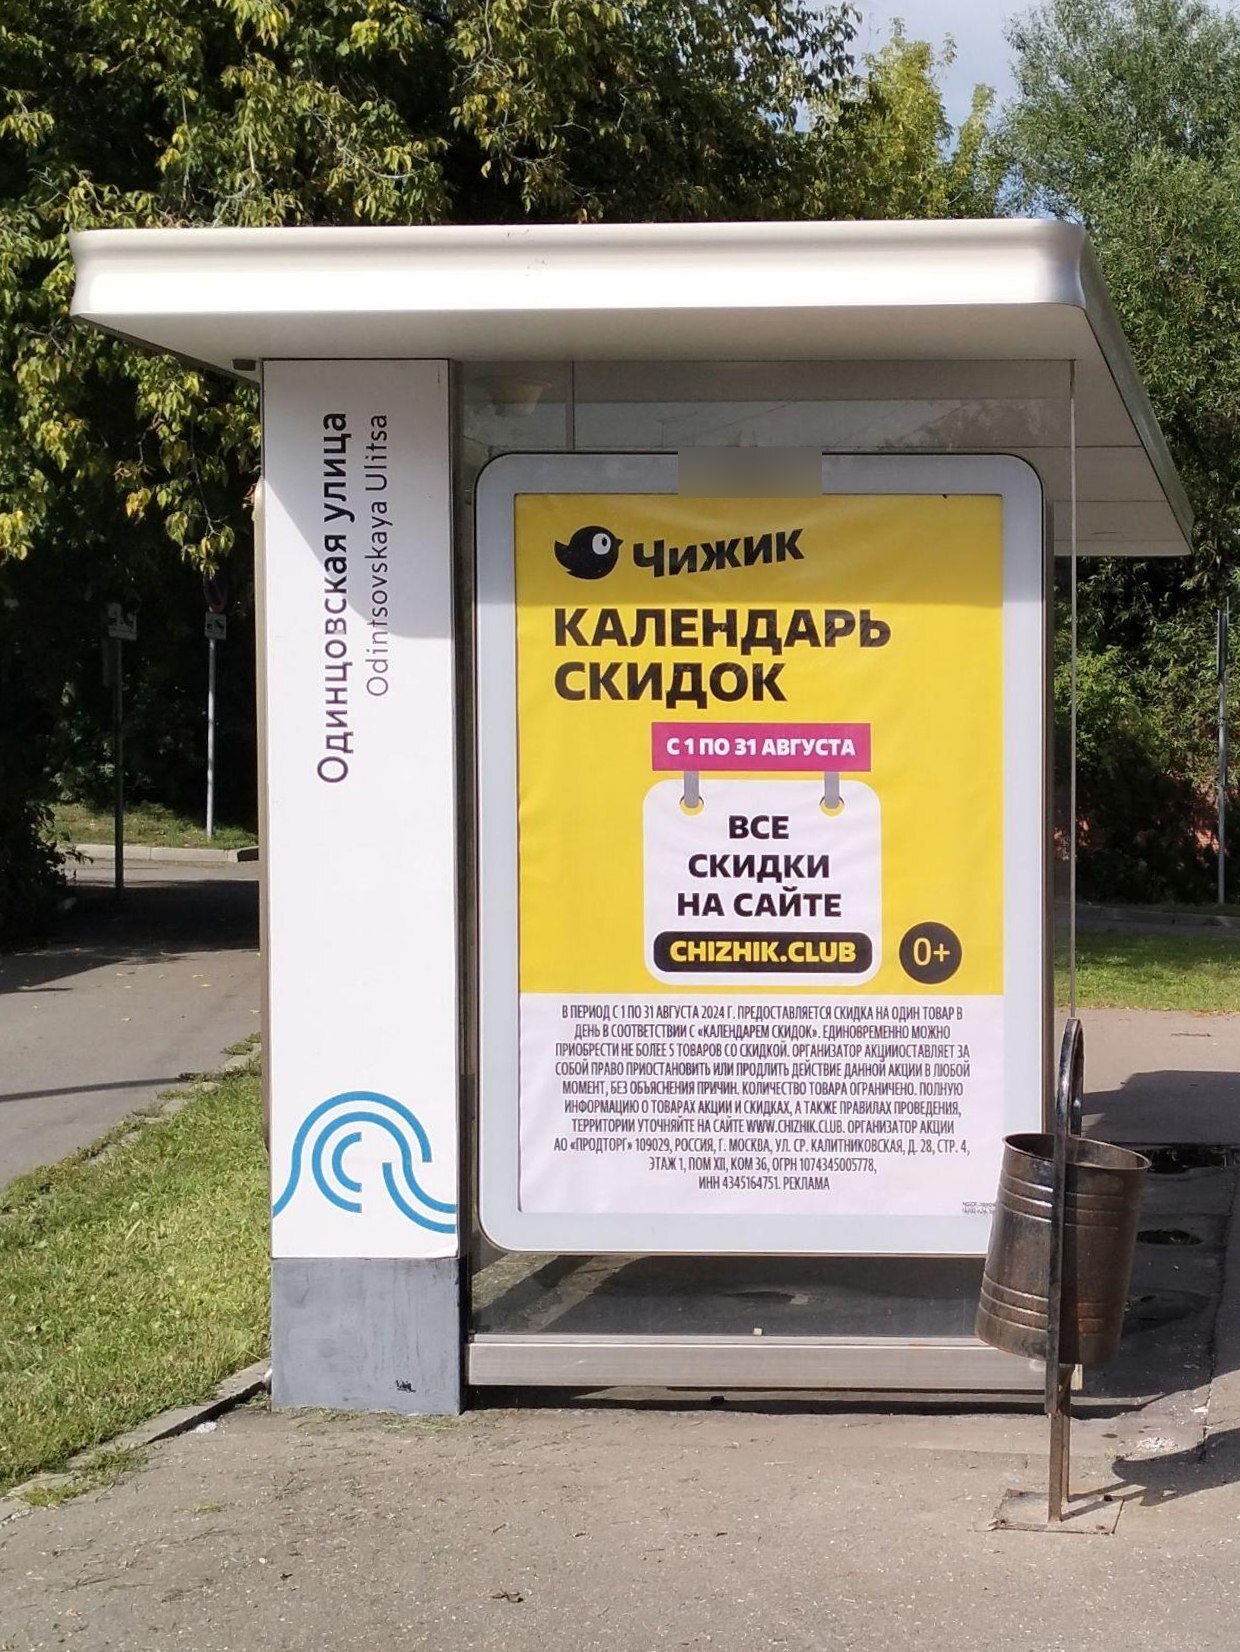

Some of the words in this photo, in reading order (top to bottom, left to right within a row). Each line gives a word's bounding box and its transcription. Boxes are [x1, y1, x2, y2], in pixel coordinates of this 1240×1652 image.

[363, 414, 388, 491] Ulitsa
[322, 412, 356, 524] улица
[363, 501, 394, 696] Odintsovskaya
[554, 608, 891, 656] КАЛЕНДАРЬ
[316, 533, 354, 784] Одинцовская
[554, 661, 787, 710] СКИДОК
[666, 737, 680, 756] С
[683, 737, 694, 755] 1
[699, 737, 730, 756] ПО
[734, 738, 757, 756] 31
[761, 738, 856, 756] АВГУСТА
[728, 815, 790, 840] ВСЕ
[688, 853, 830, 884] СКИДКИ
[677, 892, 725, 917] НА
[733, 885, 842, 918] САЙТЕ
[669, 940, 857, 963] CHIZHIK.CLUB
[913, 937, 951, 966] 0+
[562, 1005, 568, 1018] В
[571, 1005, 610, 1021] ПЕРИОД
[613, 1005, 618, 1018] С
[621, 1005, 625, 1018] 1
[628, 1005, 641, 1018] ПО
[644, 1005, 653, 1018] 31
[656, 1005, 699, 1019] АВГУСТА
[702, 1005, 724, 1019] 2024
[728, 1006, 735, 1019] Г.
[738, 1006, 831, 1022] ПРЕДОСТАВЛЯЕТСЯ
[834, 1006, 873, 1022] СКИДКА
[876, 1006, 889, 1019] НА
[892, 1007, 919, 1022] ОДИН
[923, 1007, 954, 1020] ТОВАР
[957, 1007, 962, 1020] В
[574, 1024, 600, 1040] ДЕНЬ
[603, 1024, 609, 1037] В
[611, 1024, 686, 1038] СООТВЕТСТВИИ
[689, 1025, 695, 1037] С
[698, 1024, 769, 1041] «КАЛЕНДАРЕМ
[772, 1025, 820, 1042] СКИДОК».
[823, 1025, 909, 1041] ЕДИНОВРЕМЕННО
[912, 1025, 950, 1039] МОЖНО
[556, 1043, 619, 1057] ПРИОБРЕСТИ
[621, 1043, 633, 1056] НЕ
[636, 1043, 666, 1057] БОЛЕЕ
[669, 1043, 674, 1057] 5
[676, 1043, 722, 1057] ТОВАРОВ
[725, 1044, 737, 1058] СО
[740, 1041, 789, 1061] СКИДКОЙ.
[792, 1044, 862, 1058] ОРГАНИЗАТОР
[958, 1045, 970, 1058] ЗА
[556, 1059, 588, 1075] СОБОЙ
[591, 1062, 624, 1075] ПРАВО
[626, 1062, 710, 1076] ПРИОСТАНОВИТЬ
[713, 1062, 733, 1076] ИЛИ
[737, 1063, 789, 1079] ПРОДЛИТЬ
[792, 1060, 841, 1079] ДЕЙСТВИЕ
[844, 1060, 885, 1079] ДАННОЙ
[888, 1063, 922, 1079] АКЦИИ
[925, 1063, 930, 1077] В
[933, 1060, 970, 1077] ЛЮБОЙ
[563, 1081, 608, 1097] МОМЕНТ,
[611, 1081, 627, 1094] БЕЗ
[630, 1081, 694, 1094] ОБЪЯСНЕНИЯ
[697, 1081, 739, 1095] ПРИЧИН.
[743, 1082, 806, 1095] КОЛИЧЕСТВО
[809, 1082, 847, 1095] ТОВАРА
[850, 1082, 917, 1095] ОГРАНИЧЕНО.
[920, 1082, 963, 1096] ПОЛНУЮ
[565, 1100, 639, 1115] ИНФОРМАЦИЮ
[642, 1100, 648, 1113] О
[651, 1100, 695, 1114] ТОВАРАХ
[698, 1100, 732, 1117] АКЦИИ
[735, 1100, 741, 1113] И
[744, 1100, 792, 1116] СКИДКАХ,
[795, 1101, 801, 1114] А
[804, 1101, 837, 1114] ТАКЖЕ
[840, 1101, 891, 1114] ПРАВИЛАХ
[894, 1101, 961, 1117] ПРОВЕДЕНИЯ,
[572, 1119, 635, 1132] ТЕРРИТОРИИ
[638, 1116, 694, 1132] УТОЧНЯЙТЕ
[698, 1119, 711, 1132] НА
[713, 1116, 744, 1132] САЙТЕ
[746, 1119, 845, 1133] WWW.CHIZHIK.CLUB.
[848, 1120, 917, 1133] ОРГАНИЗАТОР
[920, 1120, 954, 1136] АКЦИИ
[554, 1138, 567, 1151] АО
[570, 1138, 632, 1154] «ПРОДТОРГ»
[635, 1138, 672, 1154] 109029,
[675, 1138, 716, 1154] РОССИЯ,
[719, 1138, 726, 1151] Г.
[729, 1138, 772, 1154] МОСКВА,
[775, 1139, 790, 1152] УЛ.
[794, 1139, 808, 1152] СР.
[811, 1139, 905, 1155] КАЛИТНИКОВСКАЯ,
[908, 1139, 917, 1155] Д.
[921, 1139, 935, 1155] 28,
[938, 1139, 958, 1152] СТР.
[961, 1140, 969, 1155] 4,
[650, 1157, 676, 1170] ЭТАЖ
[679, 1158, 686, 1173] 1,
[689, 1157, 711, 1170] ПОМ
[714, 1157, 728, 1173] XII,
[731, 1157, 753, 1170] КОМ
[756, 1157, 770, 1172] 36,
[772, 1158, 797, 1171] ОГРН
[800, 1158, 876, 1173] 1074345005778,
[699, 1176, 720, 1189] ИНН
[723, 1176, 780, 1189] 4345164751.
[784, 1177, 830, 1190] РЕКЛАМА
